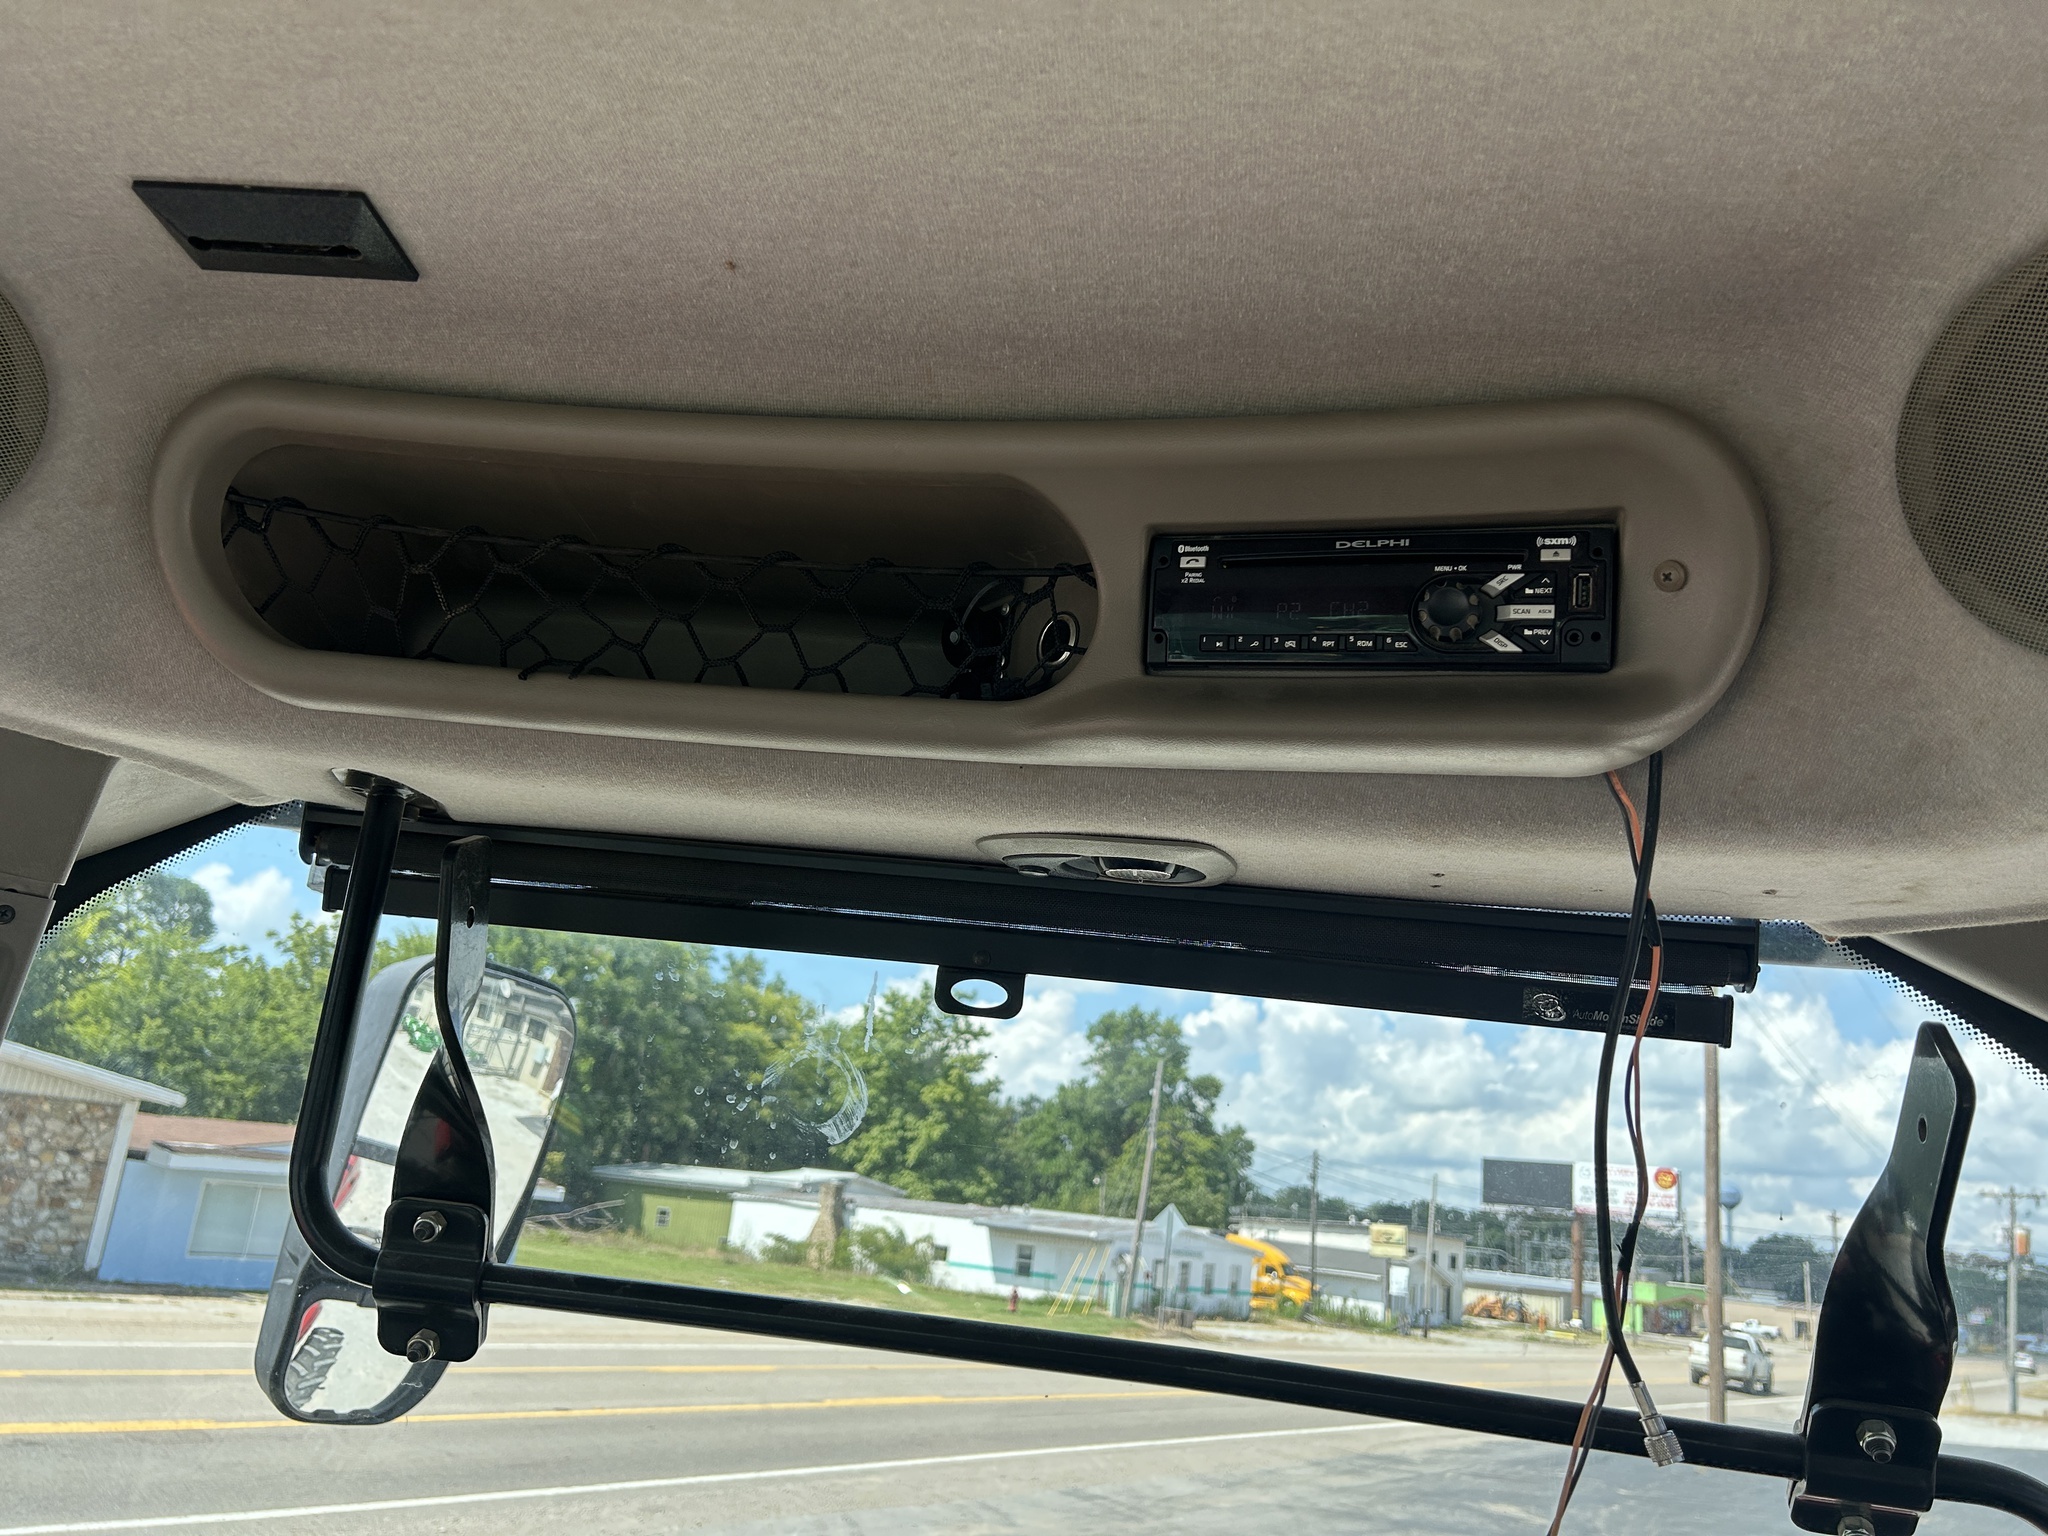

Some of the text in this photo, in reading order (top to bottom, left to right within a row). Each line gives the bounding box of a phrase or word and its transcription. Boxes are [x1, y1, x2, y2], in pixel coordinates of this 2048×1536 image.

[1335, 538, 1410, 549] DELPHI
[1544, 537, 1569, 545] sxm
[1185, 545, 1209, 553] Bluetooth
[1507, 563, 1522, 571] PWR
[1495, 575, 1509, 587] SRC
[1533, 628, 1552, 636] PREV
[1237, 635, 1243, 643] 2
[1273, 636, 1279, 644] 3
[1493, 637, 1509, 648] DISP
